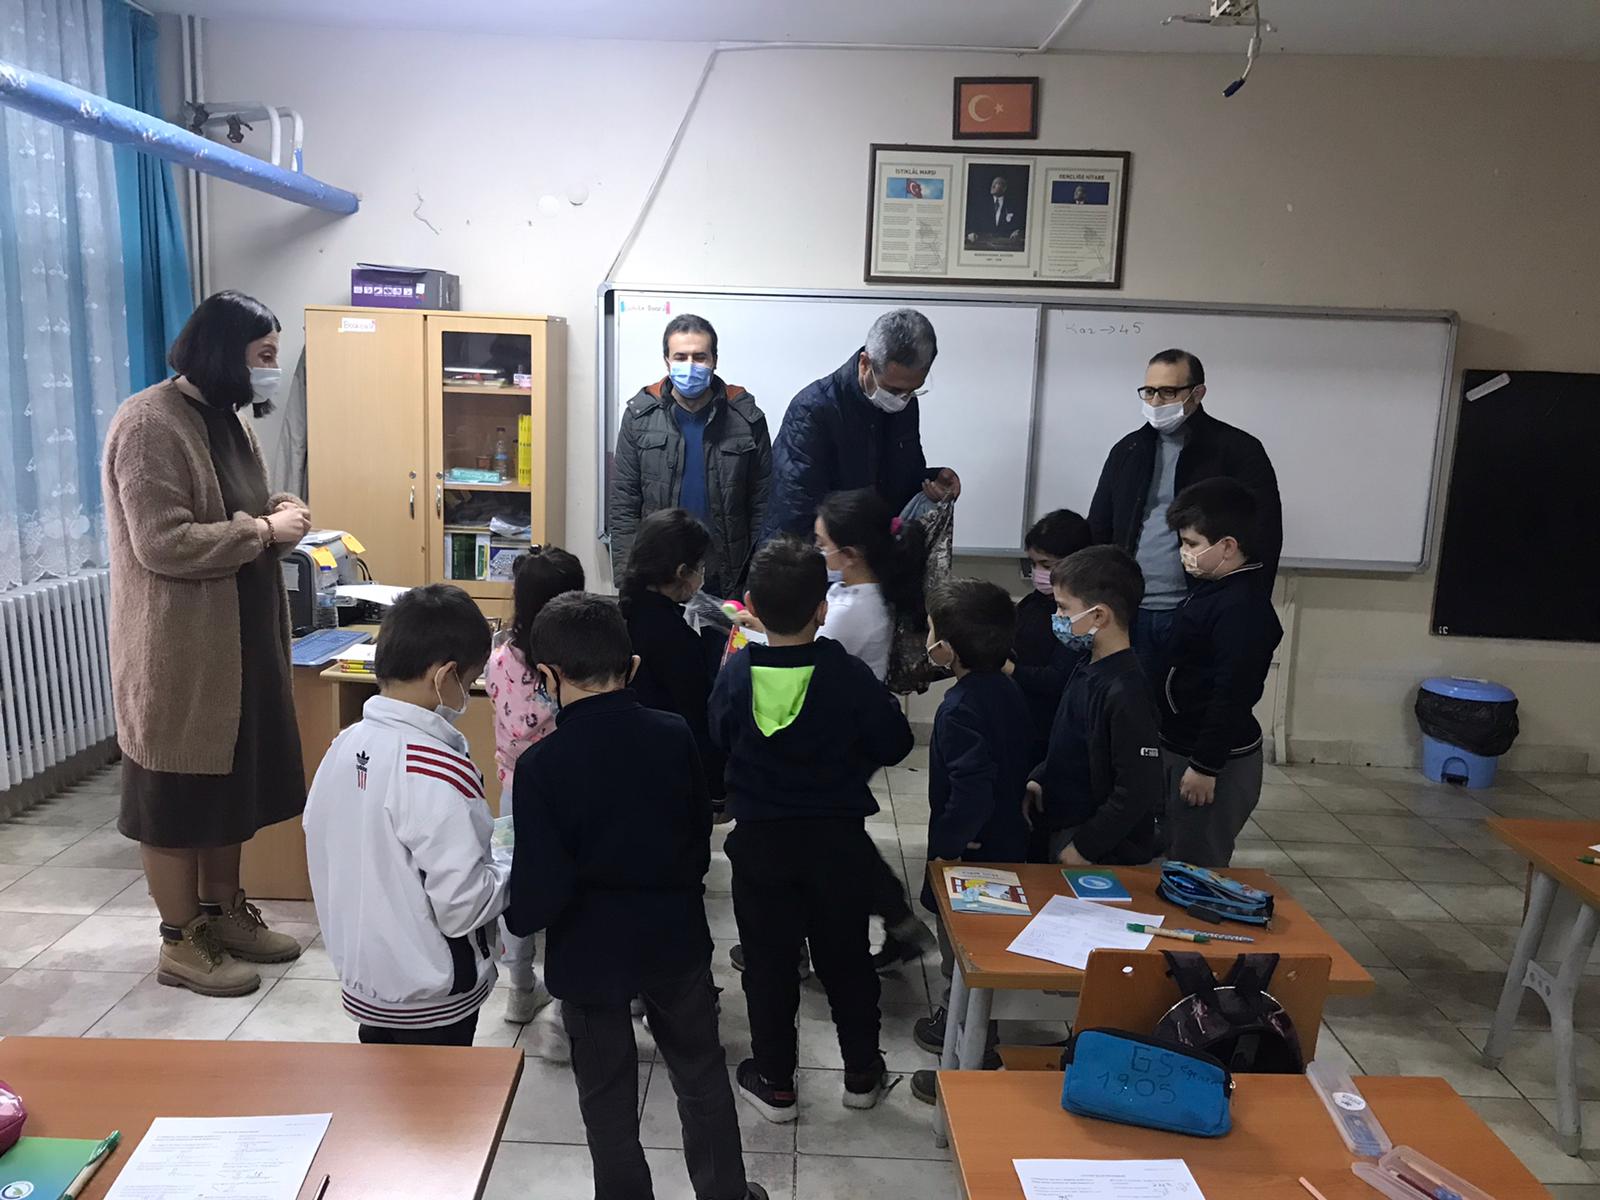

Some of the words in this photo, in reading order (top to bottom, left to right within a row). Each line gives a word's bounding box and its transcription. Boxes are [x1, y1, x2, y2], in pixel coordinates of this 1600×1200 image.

[1119, 321, 1145, 335] 45
[1130, 1045, 1175, 1078] GS
[1097, 1070, 1177, 1104] 1905
